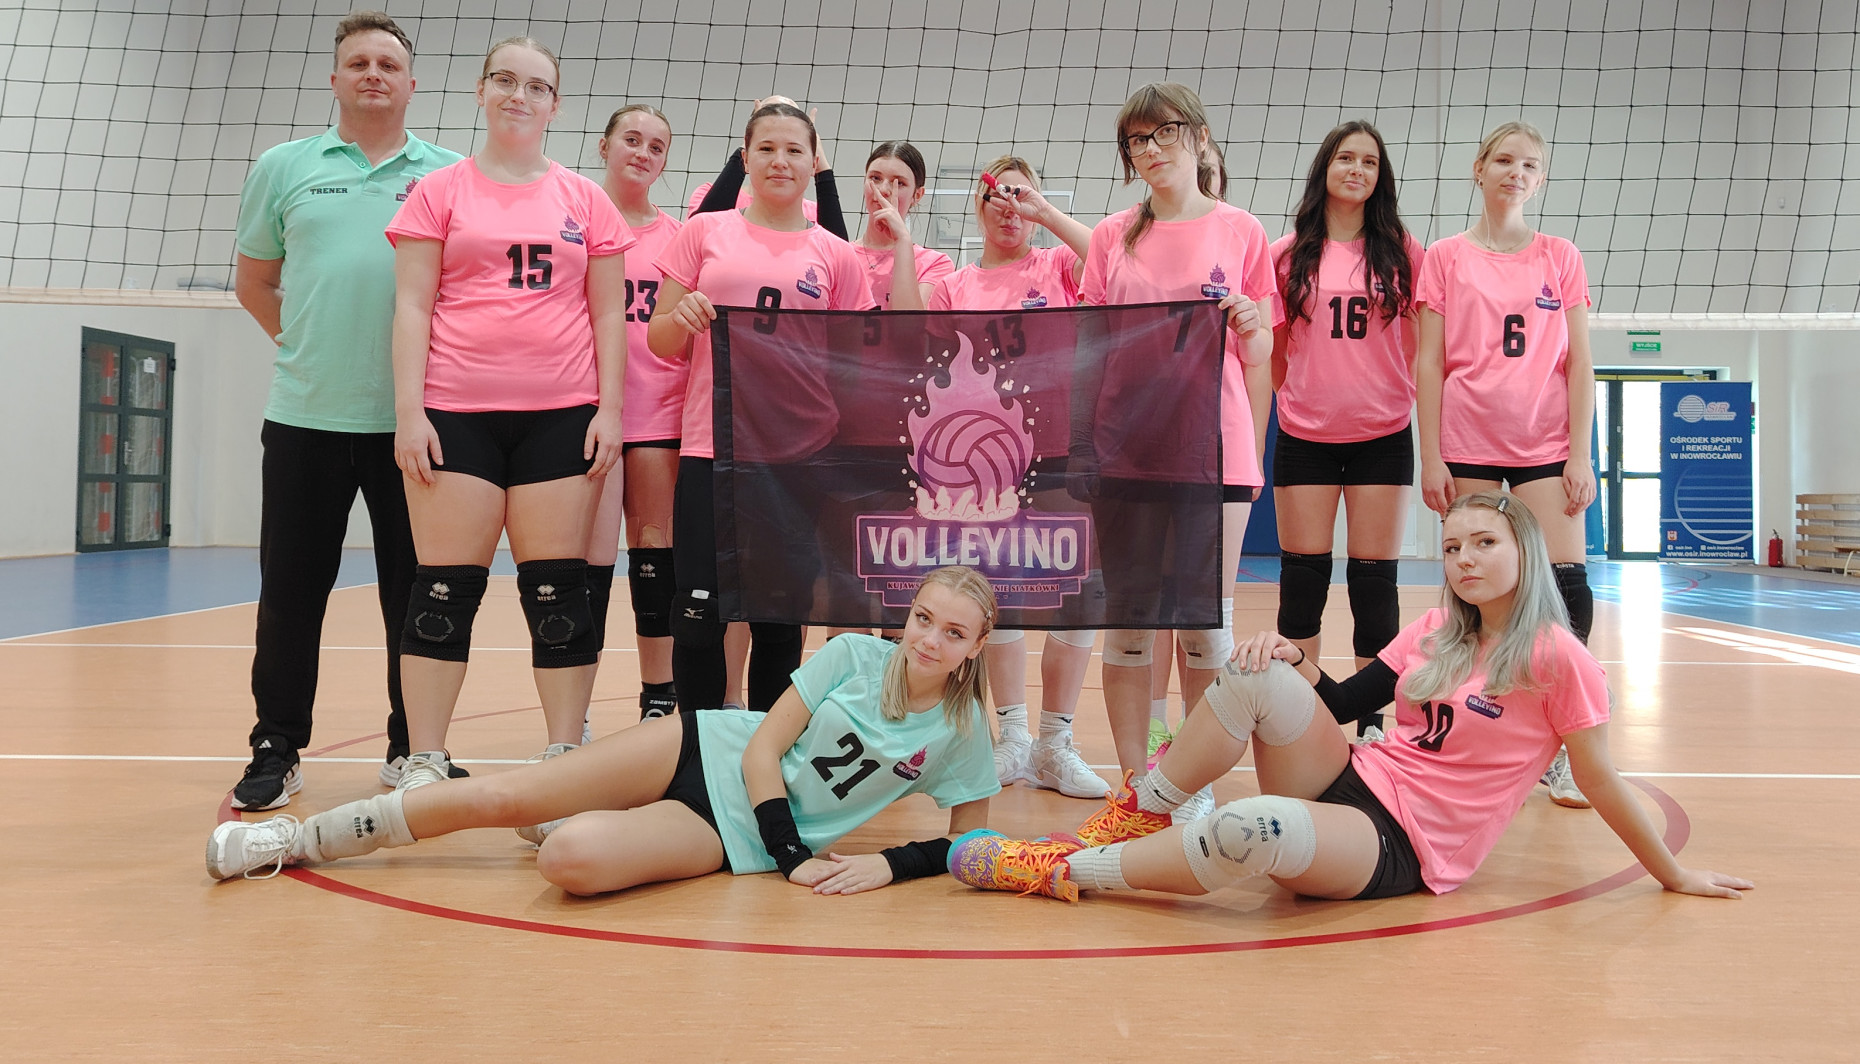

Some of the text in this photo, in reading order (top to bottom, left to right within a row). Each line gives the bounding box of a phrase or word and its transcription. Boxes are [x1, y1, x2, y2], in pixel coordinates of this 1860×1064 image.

[506, 244, 552, 290] 15
[753, 286, 782, 335] 9
[1168, 303, 1194, 353] 7
[1328, 296, 1368, 339] 16
[985, 314, 1026, 361] 13
[1503, 314, 1525, 357] 6
[1670, 435, 1709, 443] OŚRODEK
[866, 526, 1078, 571] VOLLEYINO
[1666, 551, 1748, 559] www.osir.inowroclaw.pl
[887, 582, 920, 590] KUJAWS
[1010, 583, 1060, 592] SIATKÓWKI
[1409, 700, 1454, 752] 10
[1467, 696, 1502, 715] VOLLEYINO
[810, 732, 881, 801] 21
